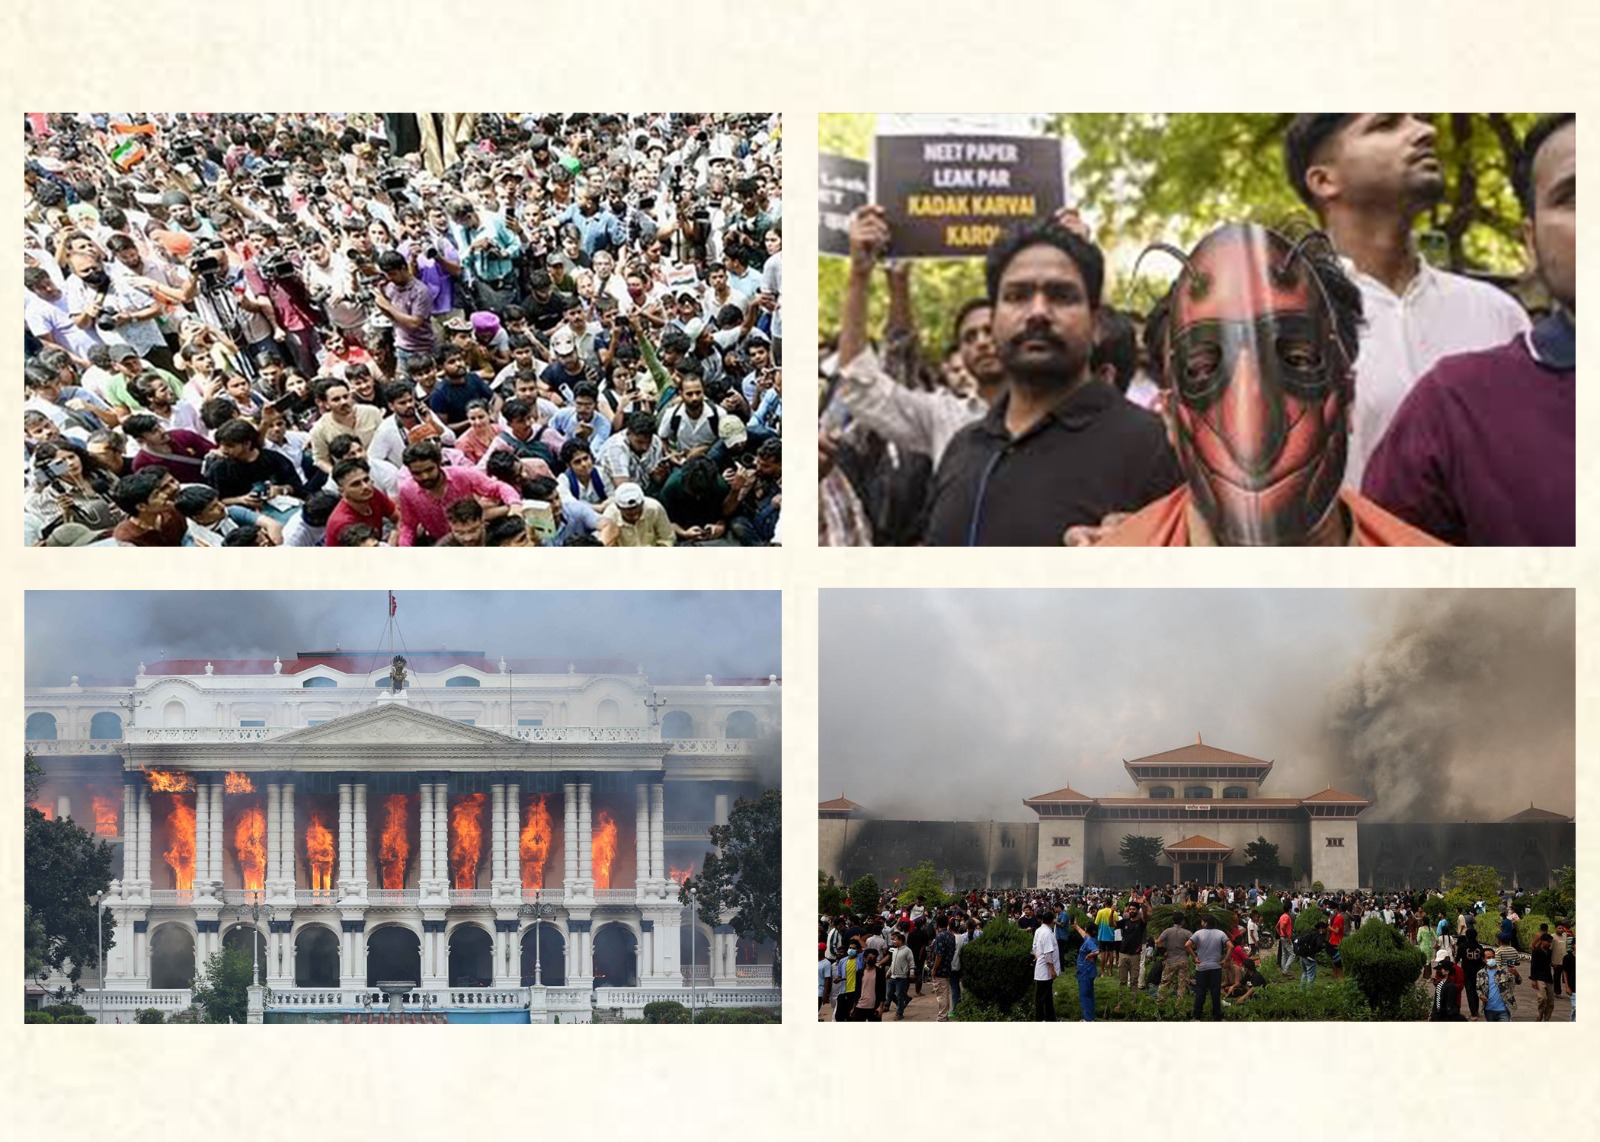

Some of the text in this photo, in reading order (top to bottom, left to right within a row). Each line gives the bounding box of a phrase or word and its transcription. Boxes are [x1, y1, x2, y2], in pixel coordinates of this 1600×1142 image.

[923, 143, 1018, 162] NEET PAPER
[934, 168, 1011, 187] LEAK PAR
[908, 195, 1035, 217] KADAK KARVAI
